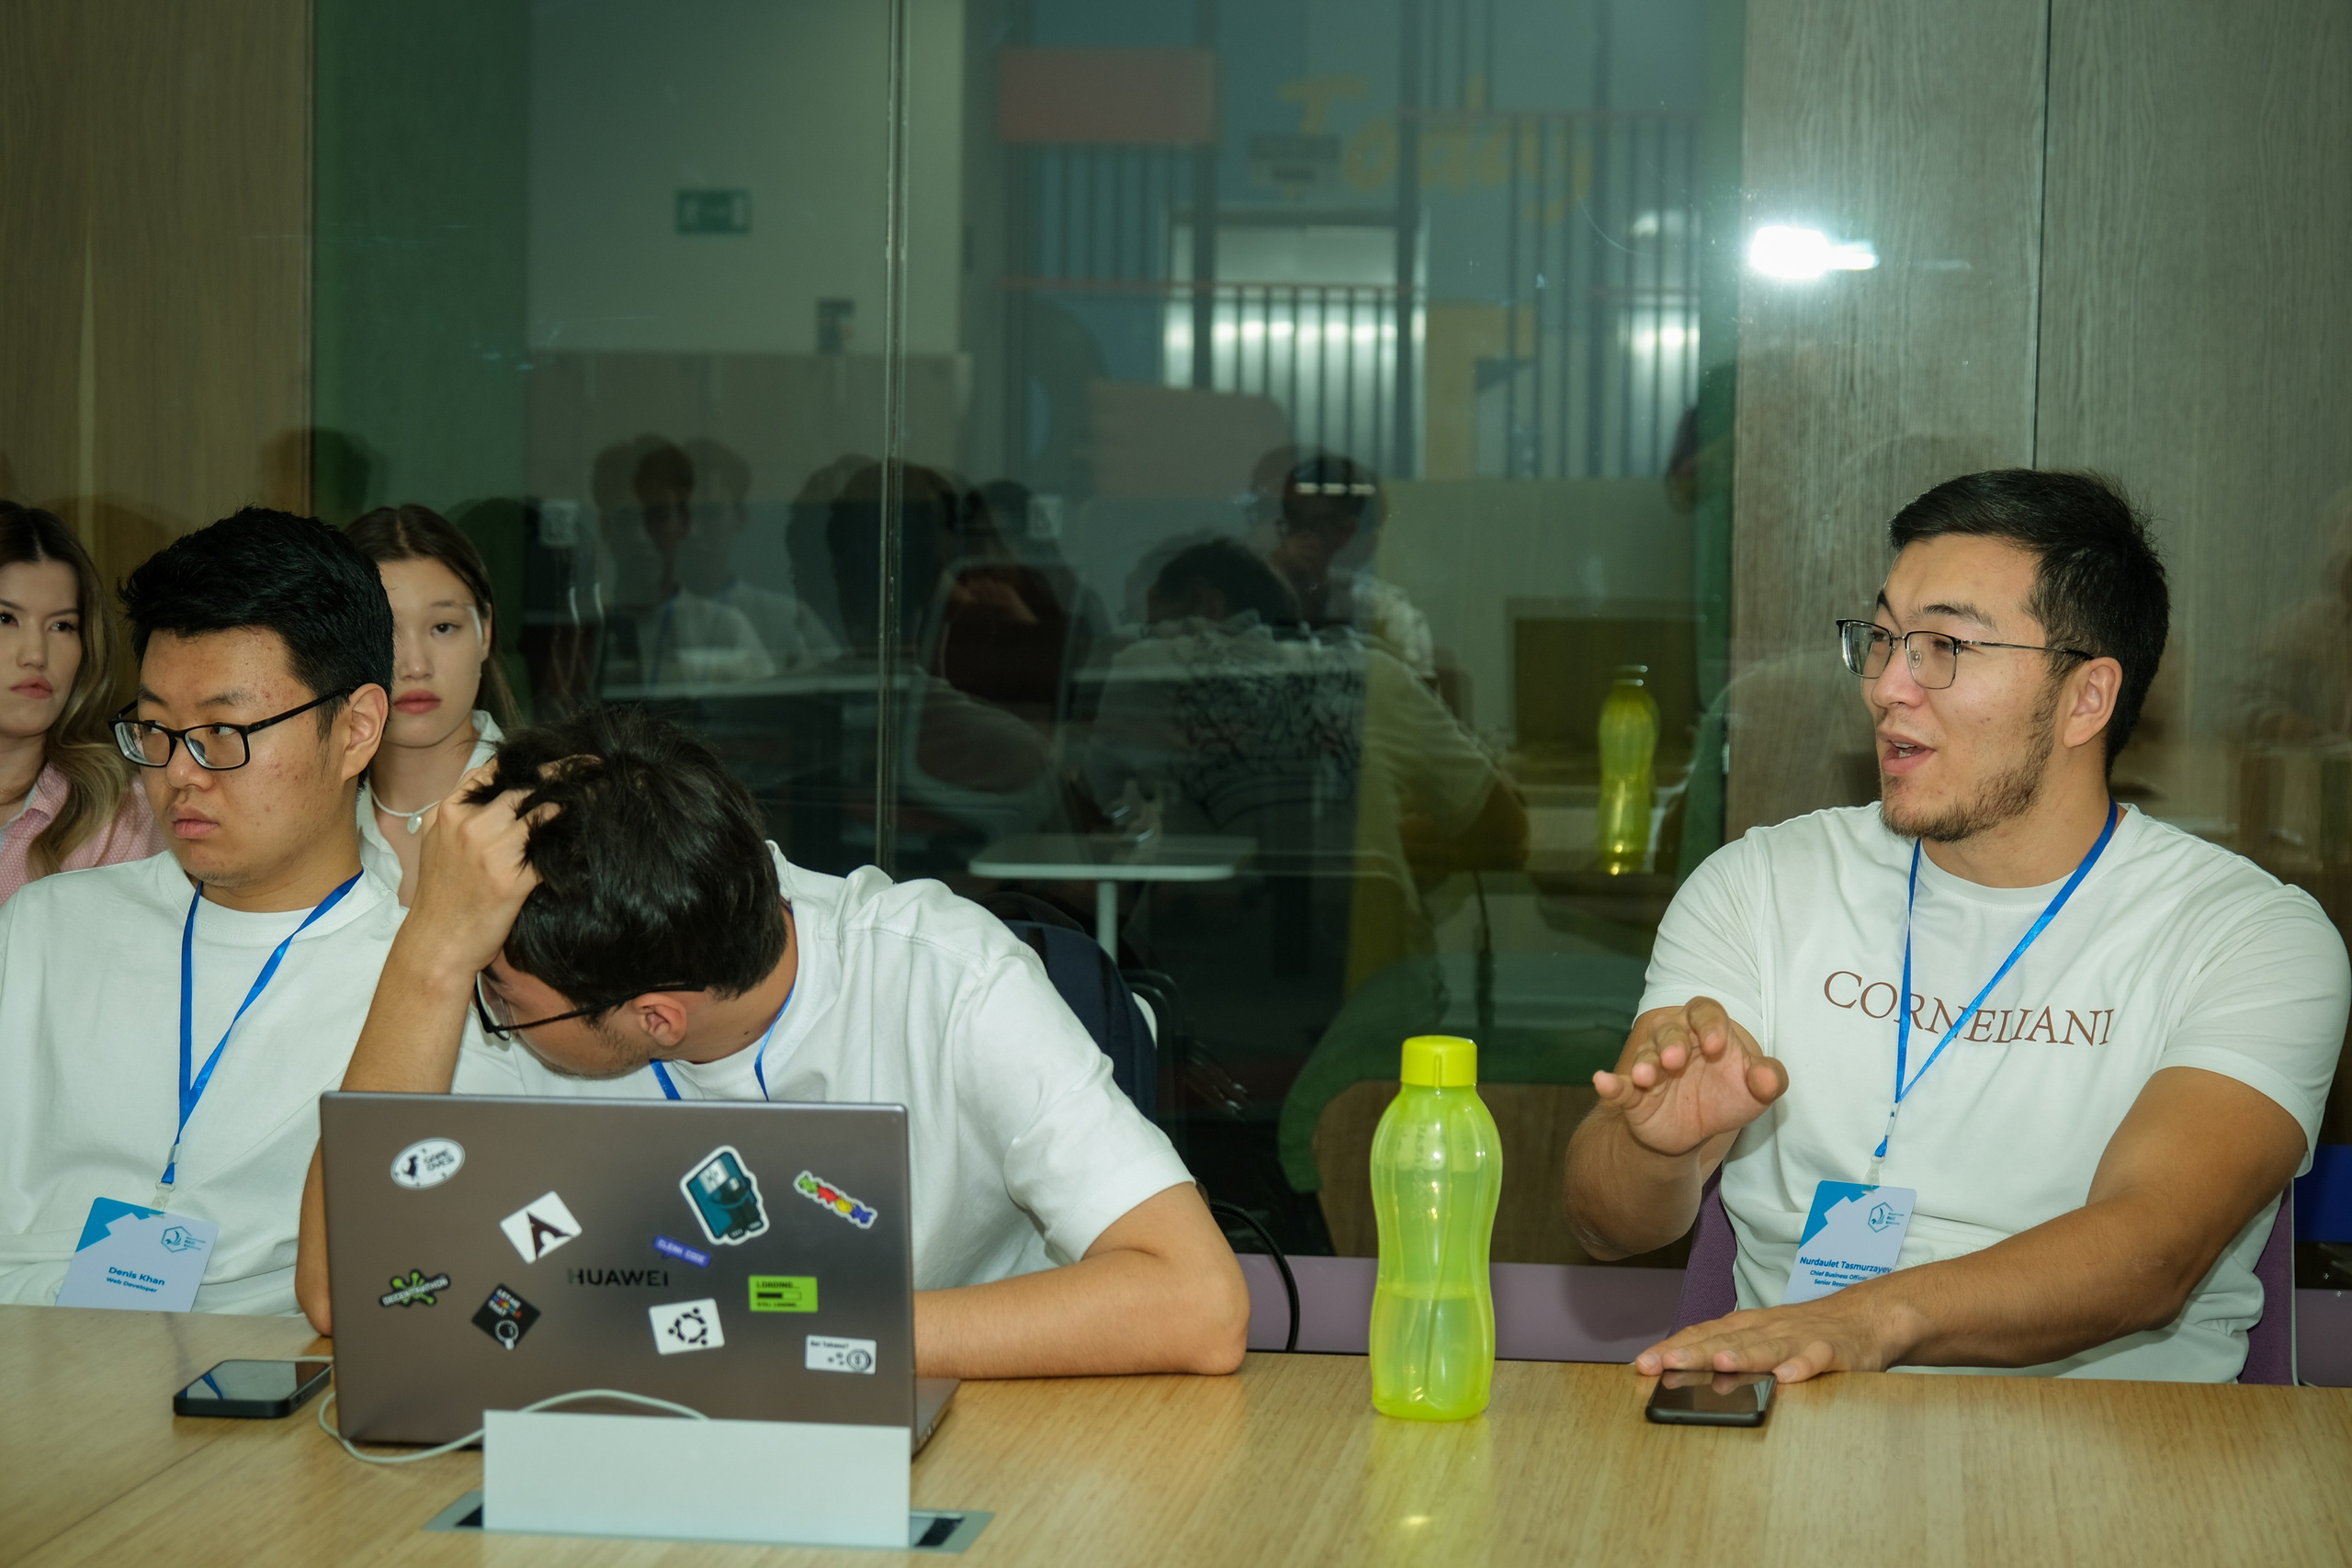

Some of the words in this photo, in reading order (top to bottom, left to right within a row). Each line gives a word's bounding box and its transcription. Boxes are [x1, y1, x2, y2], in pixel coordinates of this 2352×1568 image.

[1824, 971, 2114, 1046] CORNELIANI
[657, 1239, 684, 1256] CLEAN
[684, 1249, 707, 1265] CODE
[1800, 1257, 1839, 1269] Nurdaulet
[1841, 1261, 1893, 1275] Tasmurzayev
[108, 1267, 137, 1280] Denis
[139, 1274, 165, 1286] Khan
[568, 1269, 669, 1287] HUAWEI
[1814, 1278, 1831, 1286] Senior
[1825, 1271, 1848, 1280] Business
[107, 1277, 122, 1285] Web
[123, 1281, 157, 1292] Developer
[496, 1289, 511, 1301] LET
[488, 1300, 507, 1316] THAT
